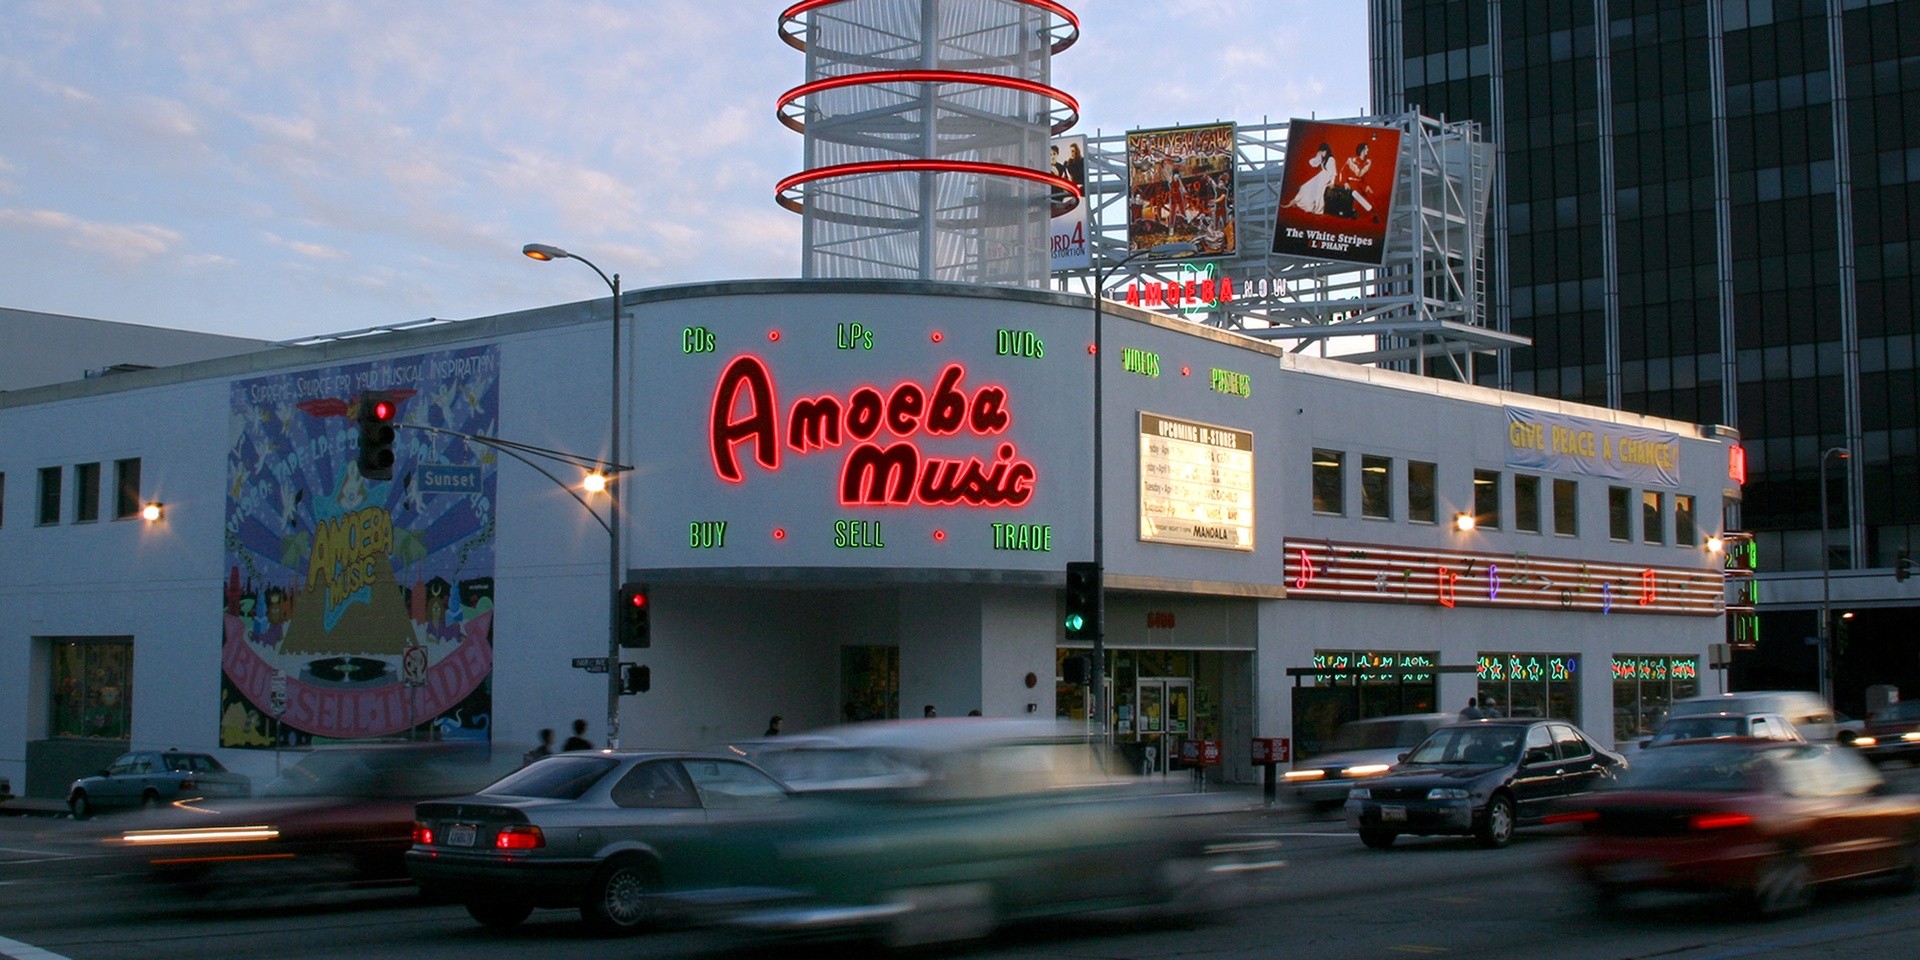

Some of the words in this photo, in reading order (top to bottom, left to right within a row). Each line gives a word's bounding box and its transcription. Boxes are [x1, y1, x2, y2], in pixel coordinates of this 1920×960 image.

[1129, 135, 1165, 154] YEAH
[1168, 133, 1195, 152] YEAH
[1198, 129, 1232, 150] YEAHS
[1286, 228, 1304, 239] The
[1307, 230, 1335, 242] White
[1338, 233, 1373, 247] Stripes
[1126, 277, 1232, 308] AMOEBA
[1243, 278, 1287, 298] NOW
[682, 326, 715, 353] CDs
[837, 323, 873, 350] LPs
[997, 329, 1044, 358] DVDs
[1122, 347, 1160, 378] VIDEOS
[297, 375, 331, 398] SOURCE
[355, 369, 379, 388] YOUR
[381, 363, 424, 386] MUSICAL
[430, 353, 495, 380] INSPIRATION
[710, 353, 1011, 483] Amoeba
[1158, 420, 1198, 442] UPCOMING
[1200, 428, 1237, 449] IN-STORES
[1509, 421, 1544, 450] GIVE
[1552, 425, 1596, 458] PEACE
[1602, 433, 1612, 460] A
[1618, 437, 1679, 468] CHANCE!
[425, 471, 475, 487] Sunset
[840, 440, 1036, 508] Music
[307, 506, 394, 593] AMOEBA
[689, 521, 727, 548] BUY
[834, 520, 884, 548] SELL
[991, 522, 1051, 551] TRADE
[1193, 525, 1228, 540] MANDALA
[329, 555, 378, 612] MUSIC
[297, 687, 370, 732] SELL
